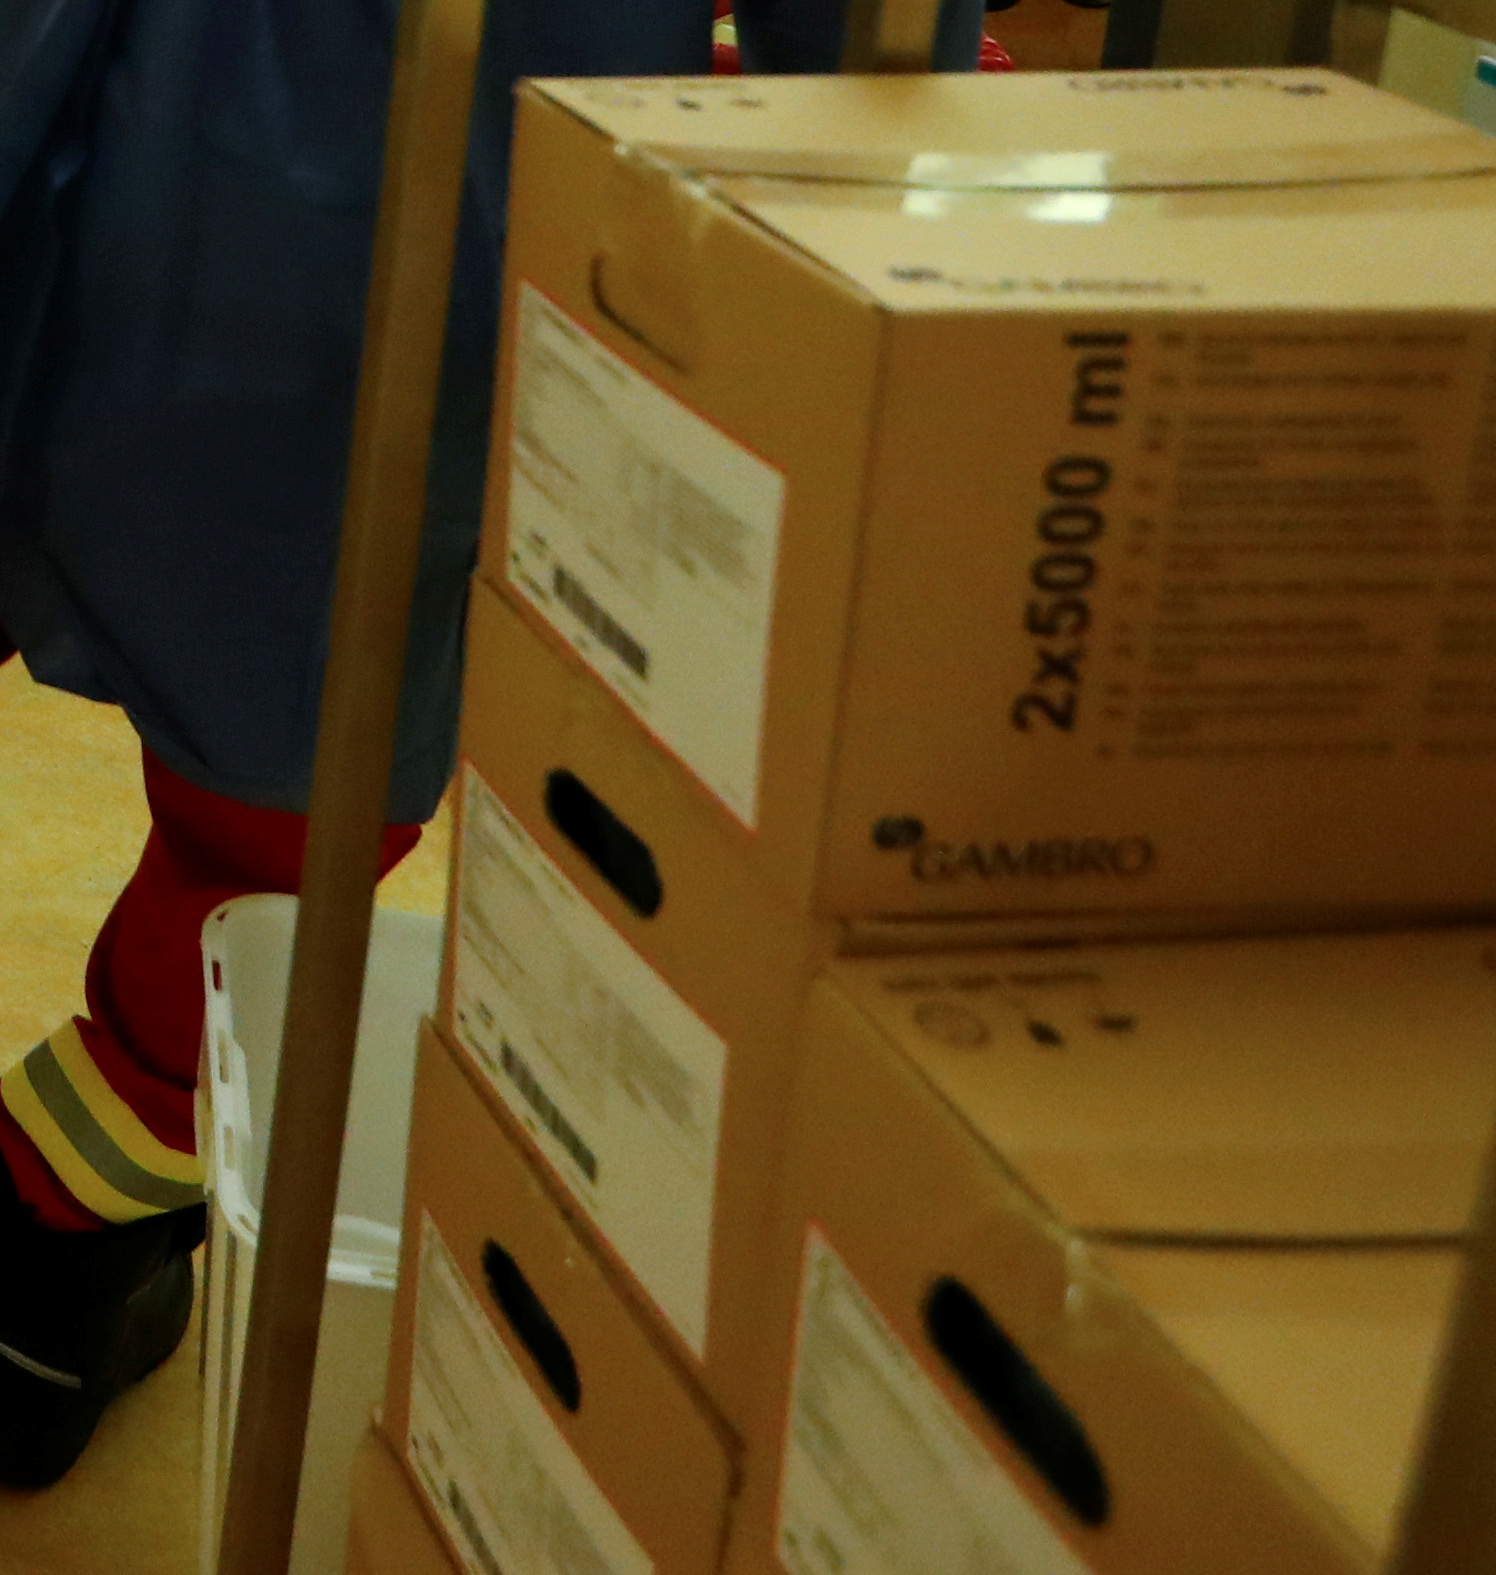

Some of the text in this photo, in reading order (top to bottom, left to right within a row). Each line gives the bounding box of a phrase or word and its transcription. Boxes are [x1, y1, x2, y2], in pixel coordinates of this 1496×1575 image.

[1010, 331, 1131, 733] 2x5000 ml
[910, 835, 1154, 879] GAMBRO
